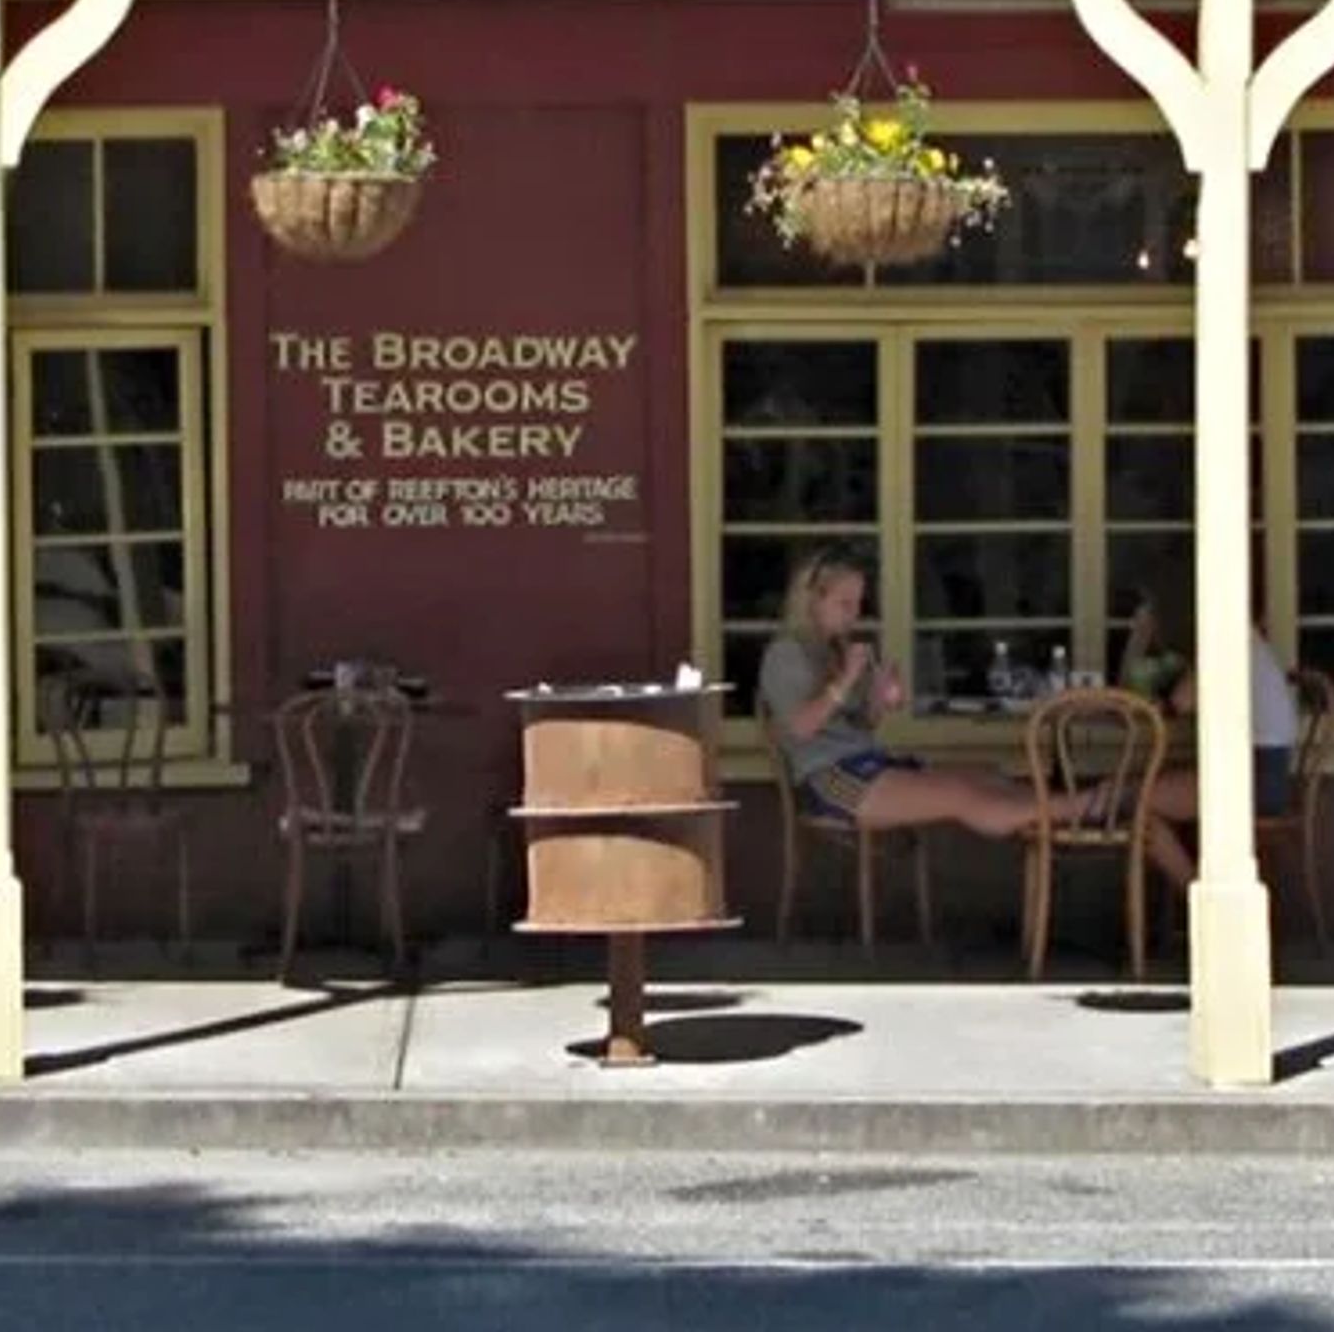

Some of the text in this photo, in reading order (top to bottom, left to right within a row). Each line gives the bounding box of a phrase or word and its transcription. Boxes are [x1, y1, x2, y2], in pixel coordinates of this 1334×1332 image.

[269, 331, 637, 370] THE BROADWAY
[320, 375, 591, 414] TEAROOMS
[324, 419, 583, 460] & BAKERY
[344, 478, 379, 502] OF
[526, 475, 638, 501] HERITAGE
[317, 503, 370, 528] FOR
[381, 502, 449, 527] OVER
[459, 502, 513, 527] 100
